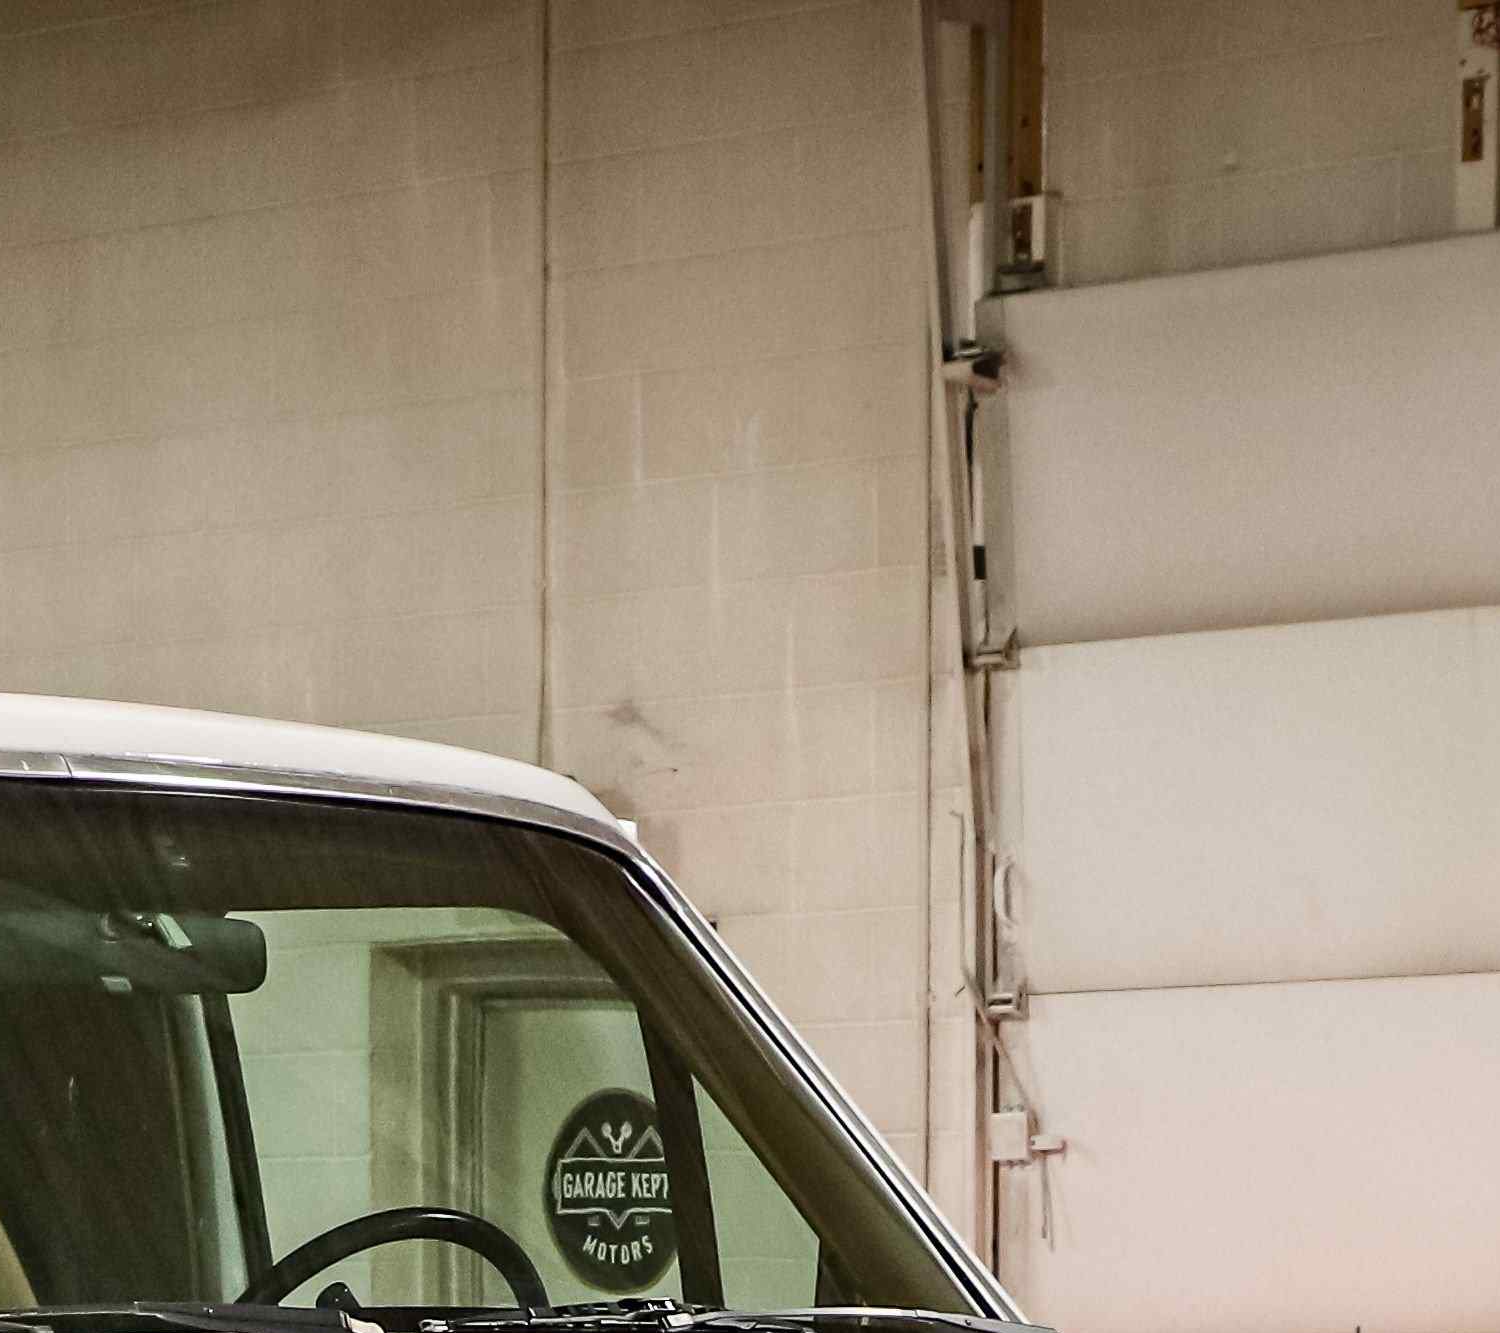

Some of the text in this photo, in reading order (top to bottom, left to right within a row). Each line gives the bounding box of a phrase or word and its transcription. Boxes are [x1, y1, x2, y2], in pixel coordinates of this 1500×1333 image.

[563, 1171, 669, 1199] GARAGE KEPT
[582, 1234, 653, 1265] MOTORS
